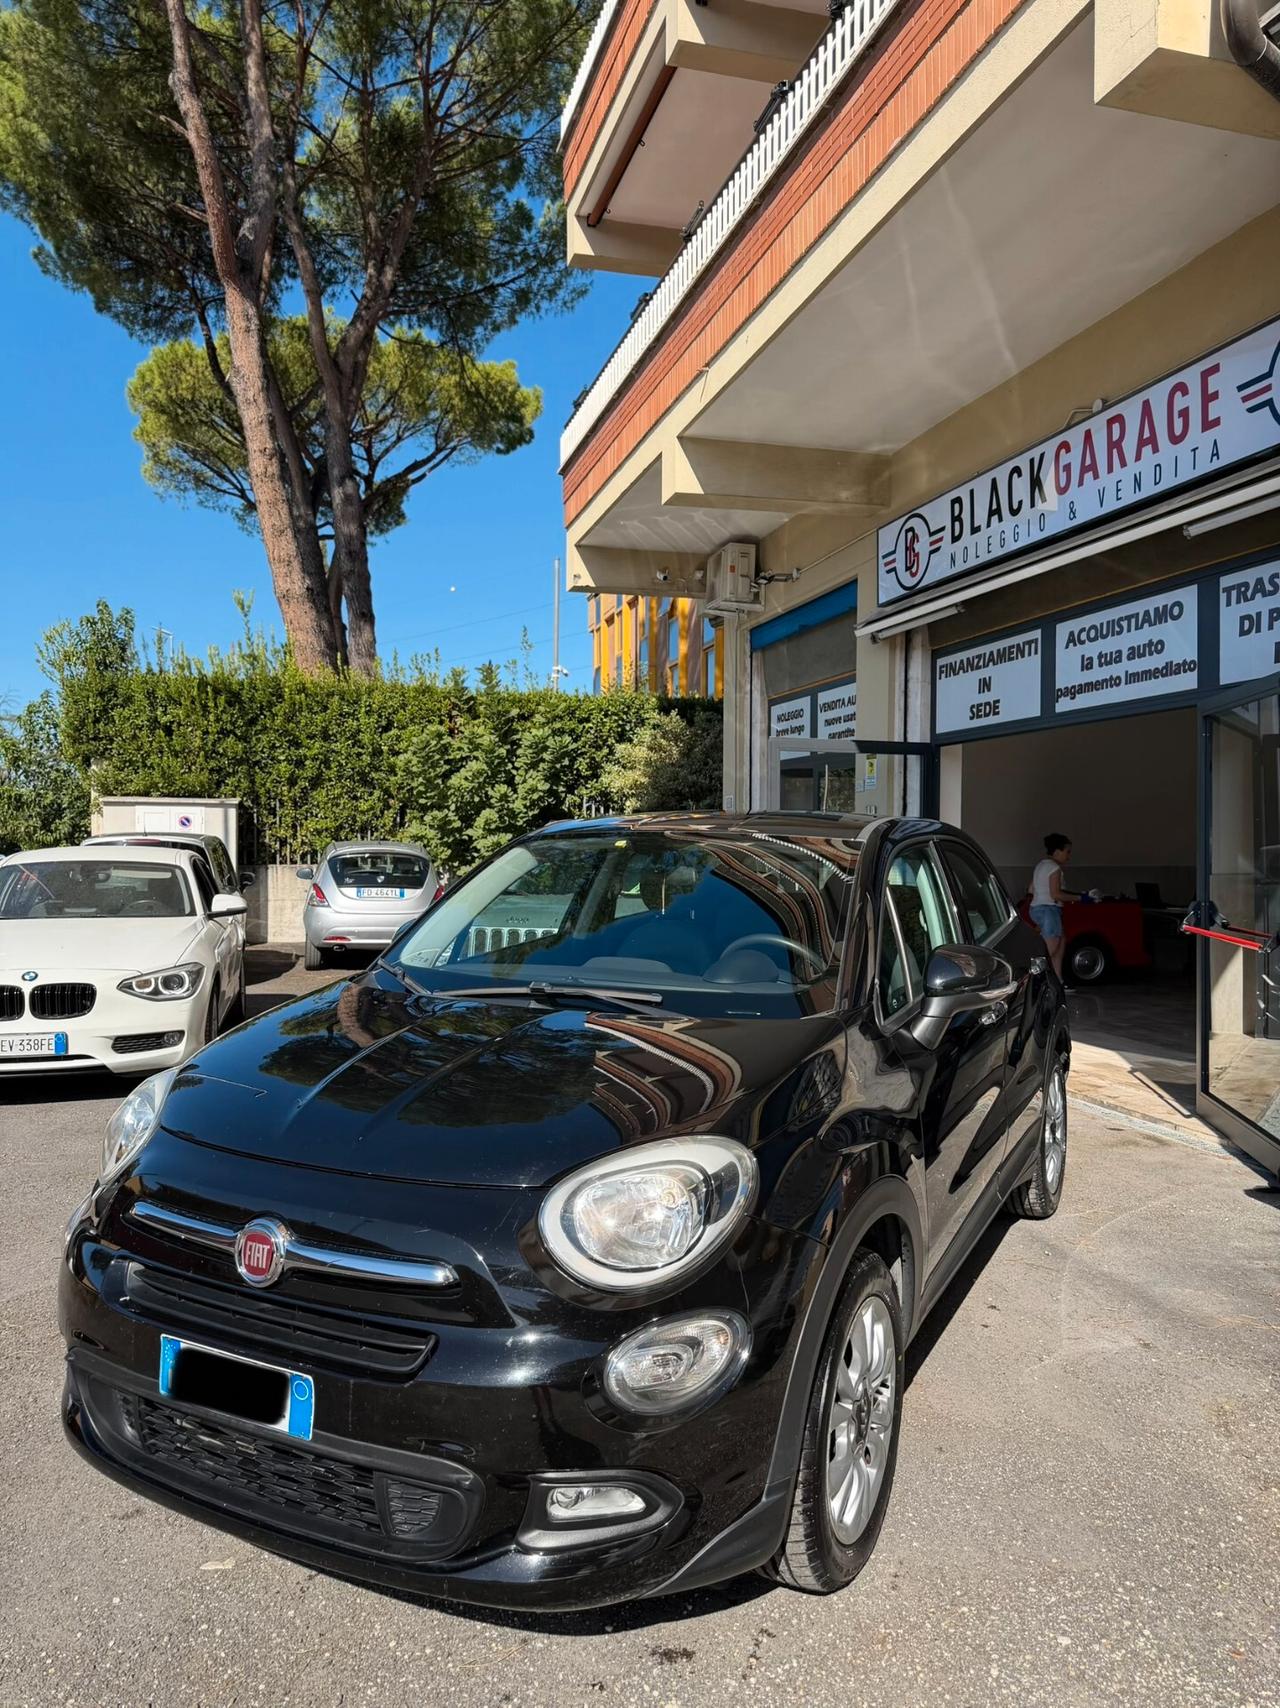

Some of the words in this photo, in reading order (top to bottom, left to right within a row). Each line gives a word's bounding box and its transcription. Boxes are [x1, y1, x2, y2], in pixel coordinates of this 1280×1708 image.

[949, 511, 1046, 569] NOLEGGIO
[1068, 500, 1078, 521] &
[1097, 438, 1221, 509] VENDITA
[1065, 600, 1184, 649] ACQUISTIAMO
[1238, 611, 1262, 637] DI
[938, 637, 1039, 681] FINANZIAMENTI
[1080, 653, 1094, 672] la
[1096, 647, 1123, 668] tua
[1126, 637, 1165, 662] auto
[978, 676, 992, 695] IN
[1055, 674, 1122, 703] pagamento
[776, 708, 805, 724] NOLEGGIO
[819, 698, 846, 713] VENDITA
[969, 699, 1001, 720] SEDE
[0, 1038, 15, 1053] EV
[18, 1037, 54, 1052] 338FE
[245, 1240, 271, 1269] FIAT
